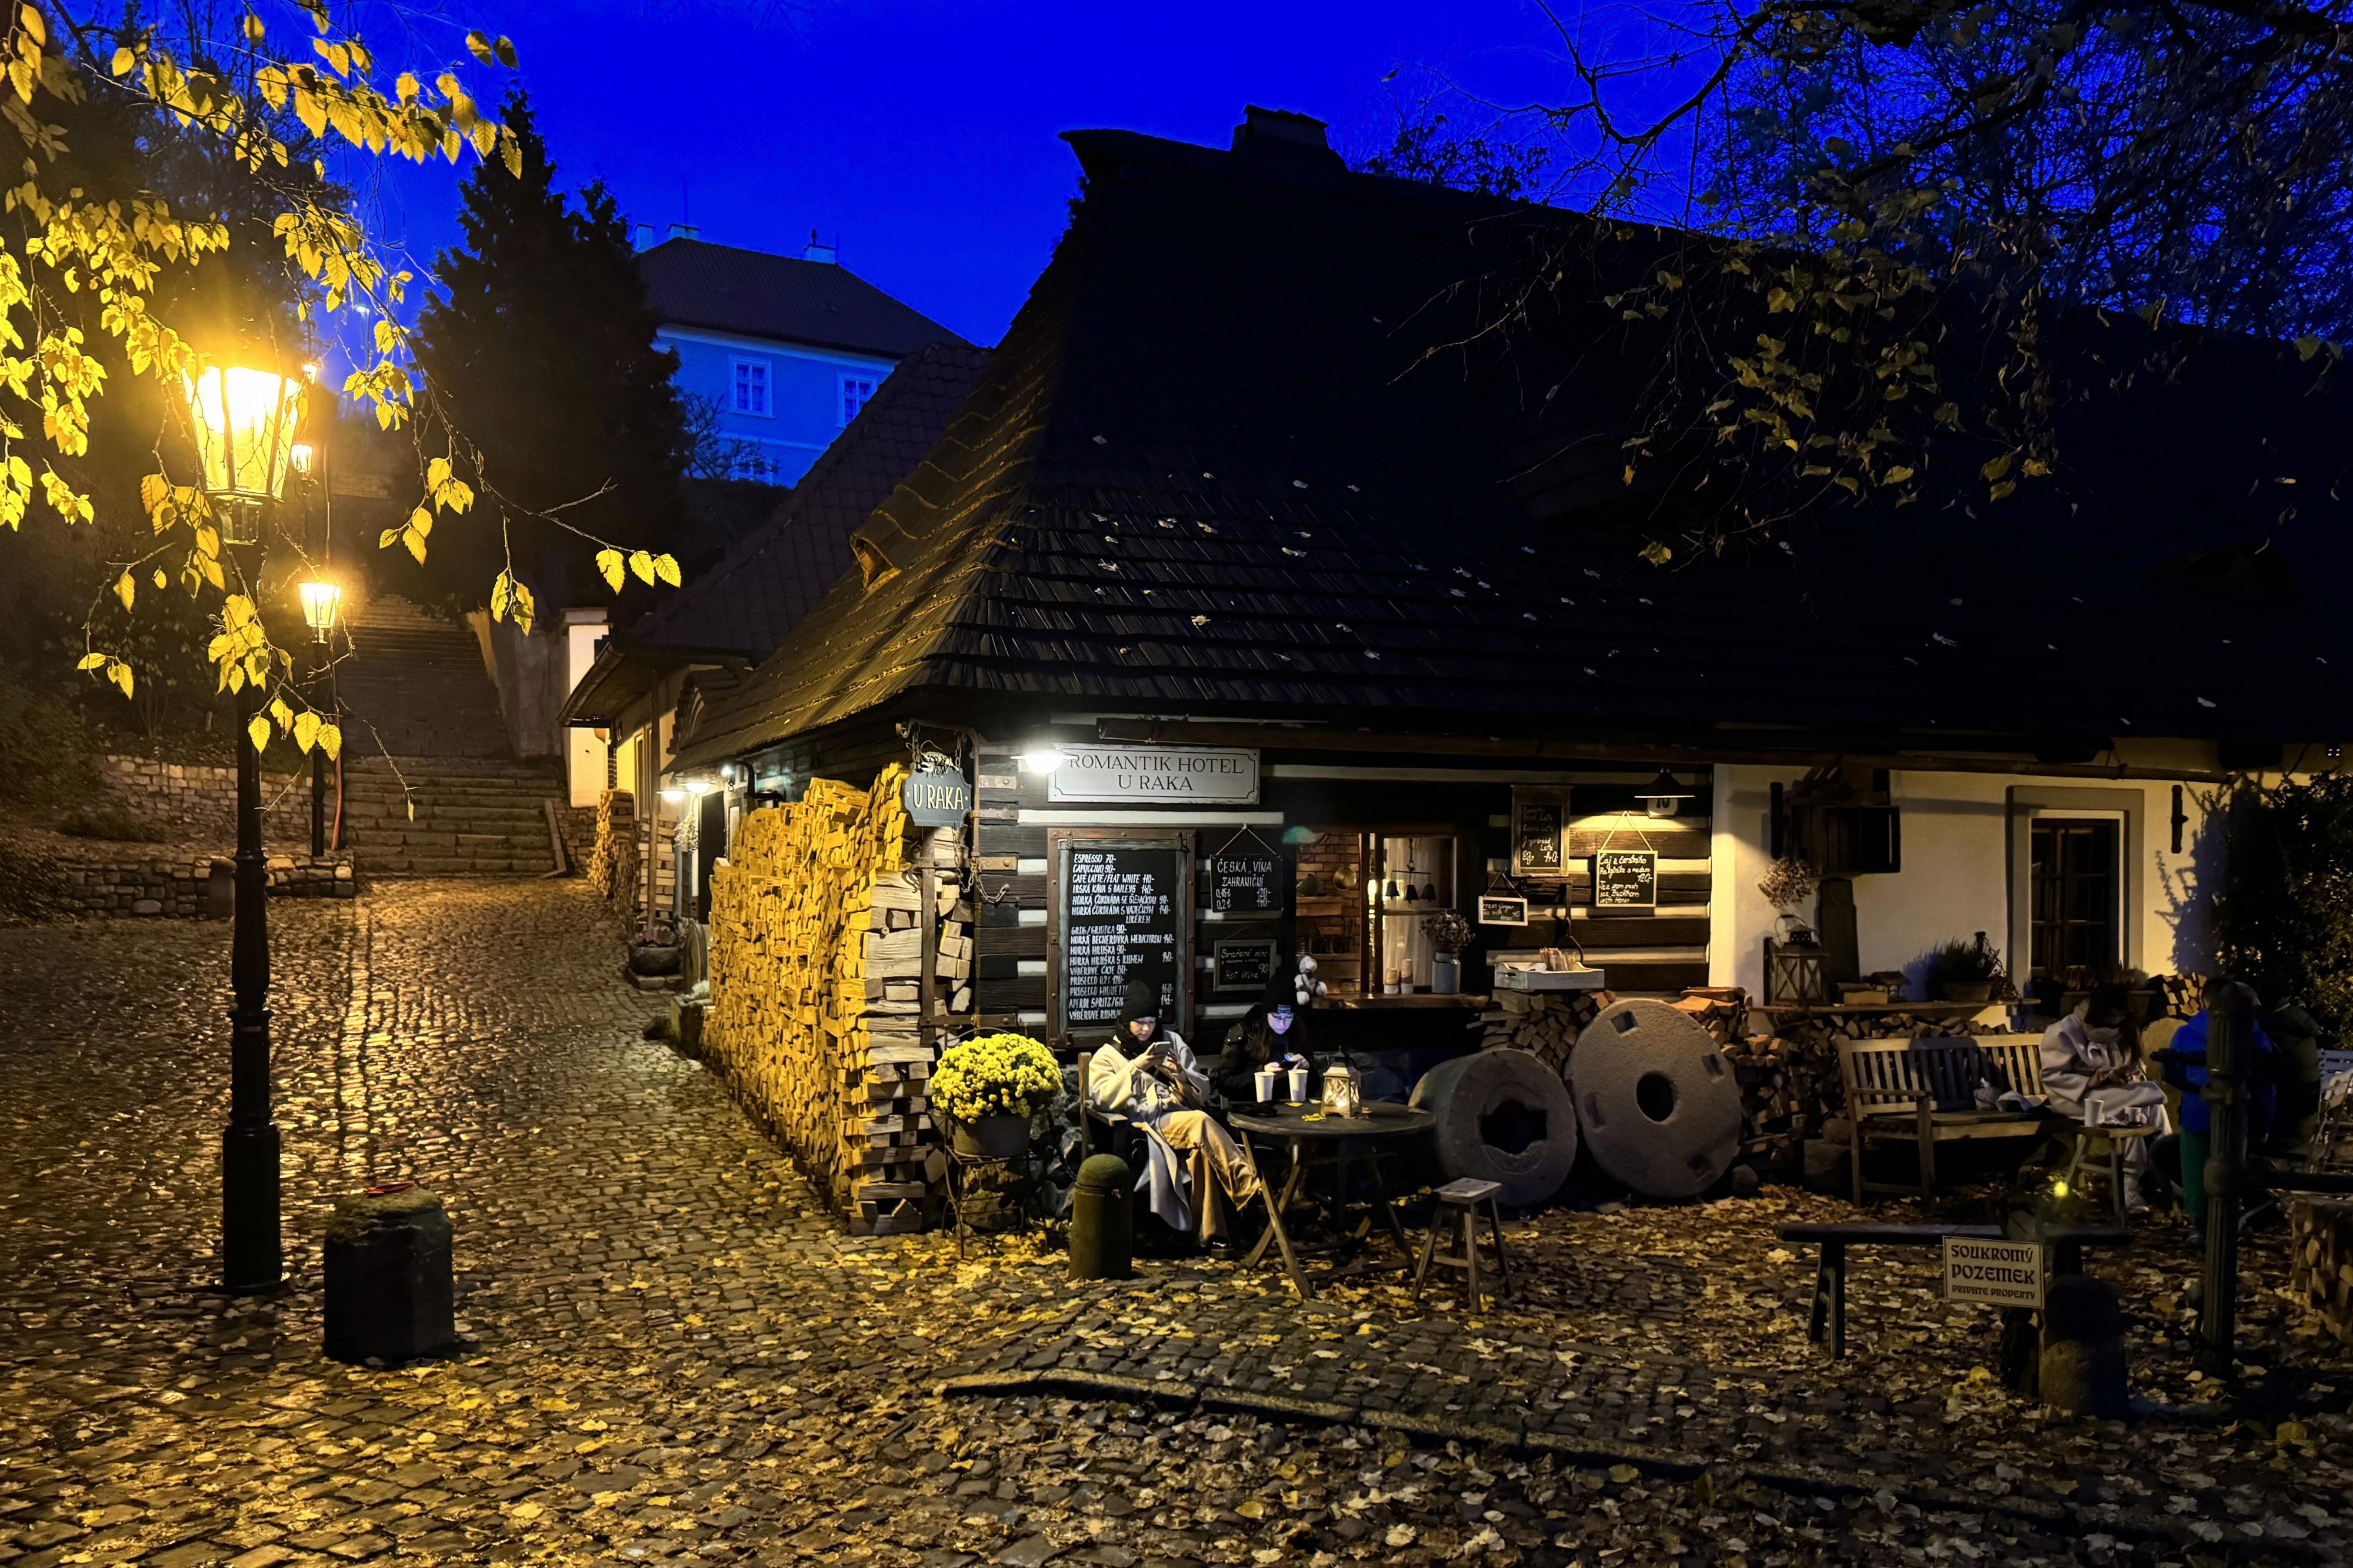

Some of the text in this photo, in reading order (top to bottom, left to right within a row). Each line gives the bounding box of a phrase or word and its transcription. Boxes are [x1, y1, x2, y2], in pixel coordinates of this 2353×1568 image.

[1071, 754, 1244, 774] ROMANTIK HOTEL
[1118, 775, 1194, 791] U RAKA
[913, 783, 964, 810] U RAKA
[1074, 853, 1102, 863] ESPRESSO
[1072, 864, 1104, 873] CAPUCCINO
[1217, 858, 1272, 873] ČESKÁ VÍNA
[1122, 873, 1141, 883] WHITE
[1222, 873, 1264, 887] ZAHRANIČNÍ
[1072, 883, 1091, 893] IRSKÁ
[1092, 883, 1106, 893] KÁVA
[1113, 884, 1136, 893] BAILEYS
[1072, 893, 1093, 905] HORKÁ
[1094, 893, 1120, 905] ČOKOLÁDA
[1121, 895, 1128, 905] SE
[1071, 904, 1092, 915] HORKÁ
[1092, 904, 1119, 915] ČOKOLÁDA
[1125, 913, 1151, 923] LIKÉREM
[1071, 934, 1091, 945] HORKÁ
[1092, 934, 1129, 945] BECHEROVKA
[1070, 944, 1091, 955] HORKÁ
[1092, 944, 1115, 955] HRUŠKA
[1069, 955, 1089, 966] HORKÁ
[1091, 955, 1115, 965] HRUŠKA
[1122, 954, 1144, 965] RUMEM
[1069, 965, 1099, 975] VÝBĚROVÉ
[1101, 965, 1115, 975] ČAJE
[1070, 976, 1098, 985] PROSECCO
[1069, 986, 1098, 996] PROSECCO
[1068, 998, 1089, 1009] APEROL
[1068, 1008, 1099, 1020] VÝBĚROVÉ
[1951, 1245, 2034, 1263] SOUKROMÝ
[1951, 1263, 2035, 1285] POZEMEK
[1952, 1285, 2035, 1300] PRIVATE PROPERTY
